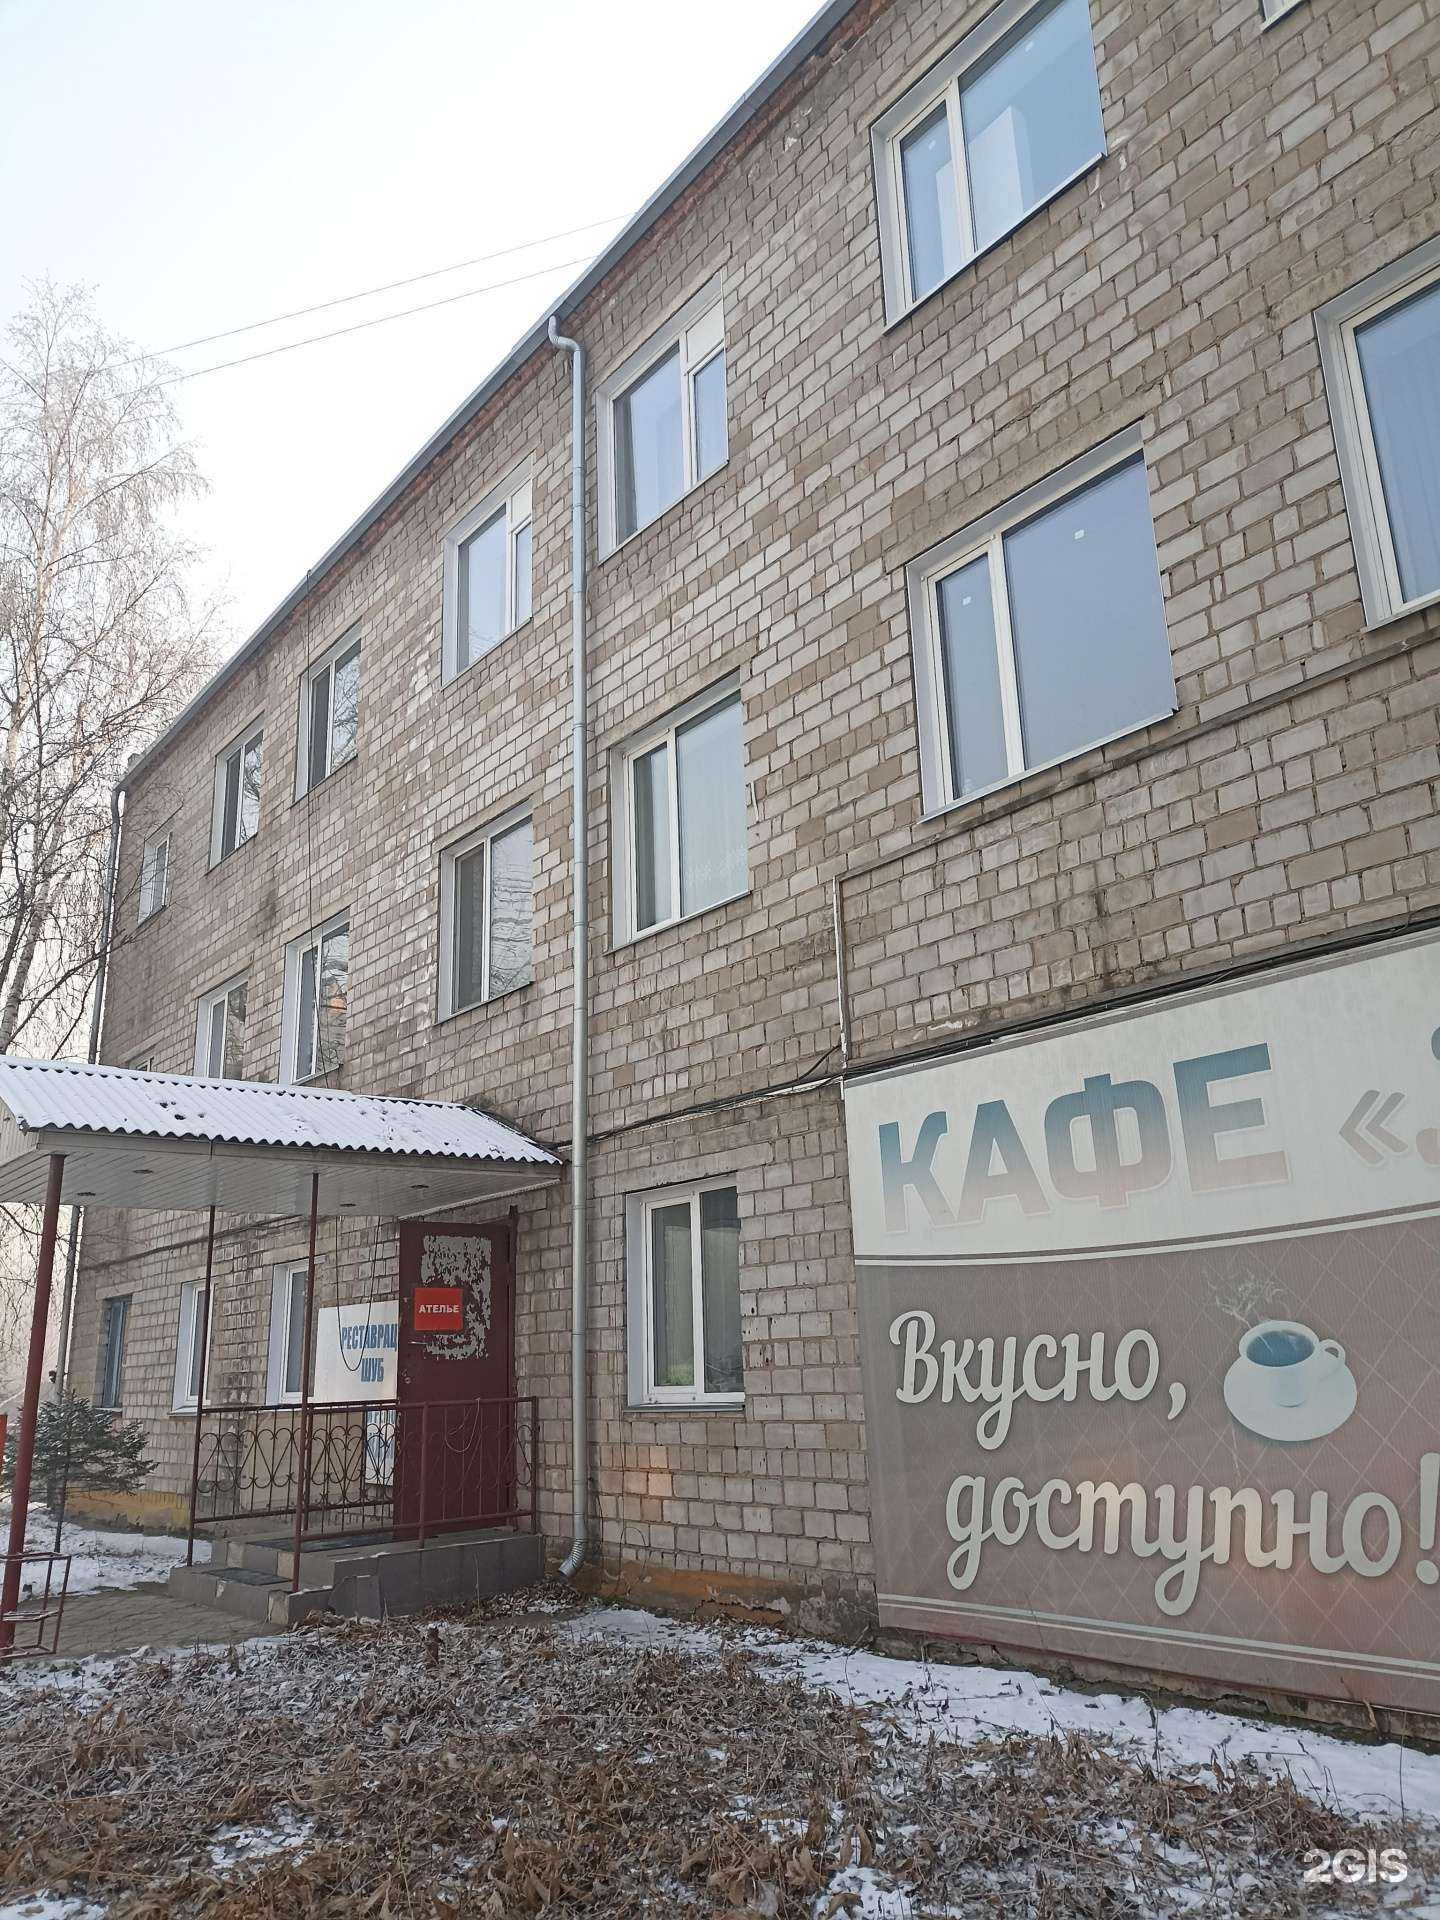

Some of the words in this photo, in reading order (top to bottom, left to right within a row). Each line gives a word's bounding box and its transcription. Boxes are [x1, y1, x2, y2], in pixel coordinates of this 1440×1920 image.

[878, 1042, 1291, 1234] КАФЕ
[361, 1357, 384, 1382] ШУБ
[418, 1303, 460, 1314] АТЕЛЬЕ
[889, 1310, 1187, 1450] Вкусно,
[945, 1452, 1440, 1616] доступно!
